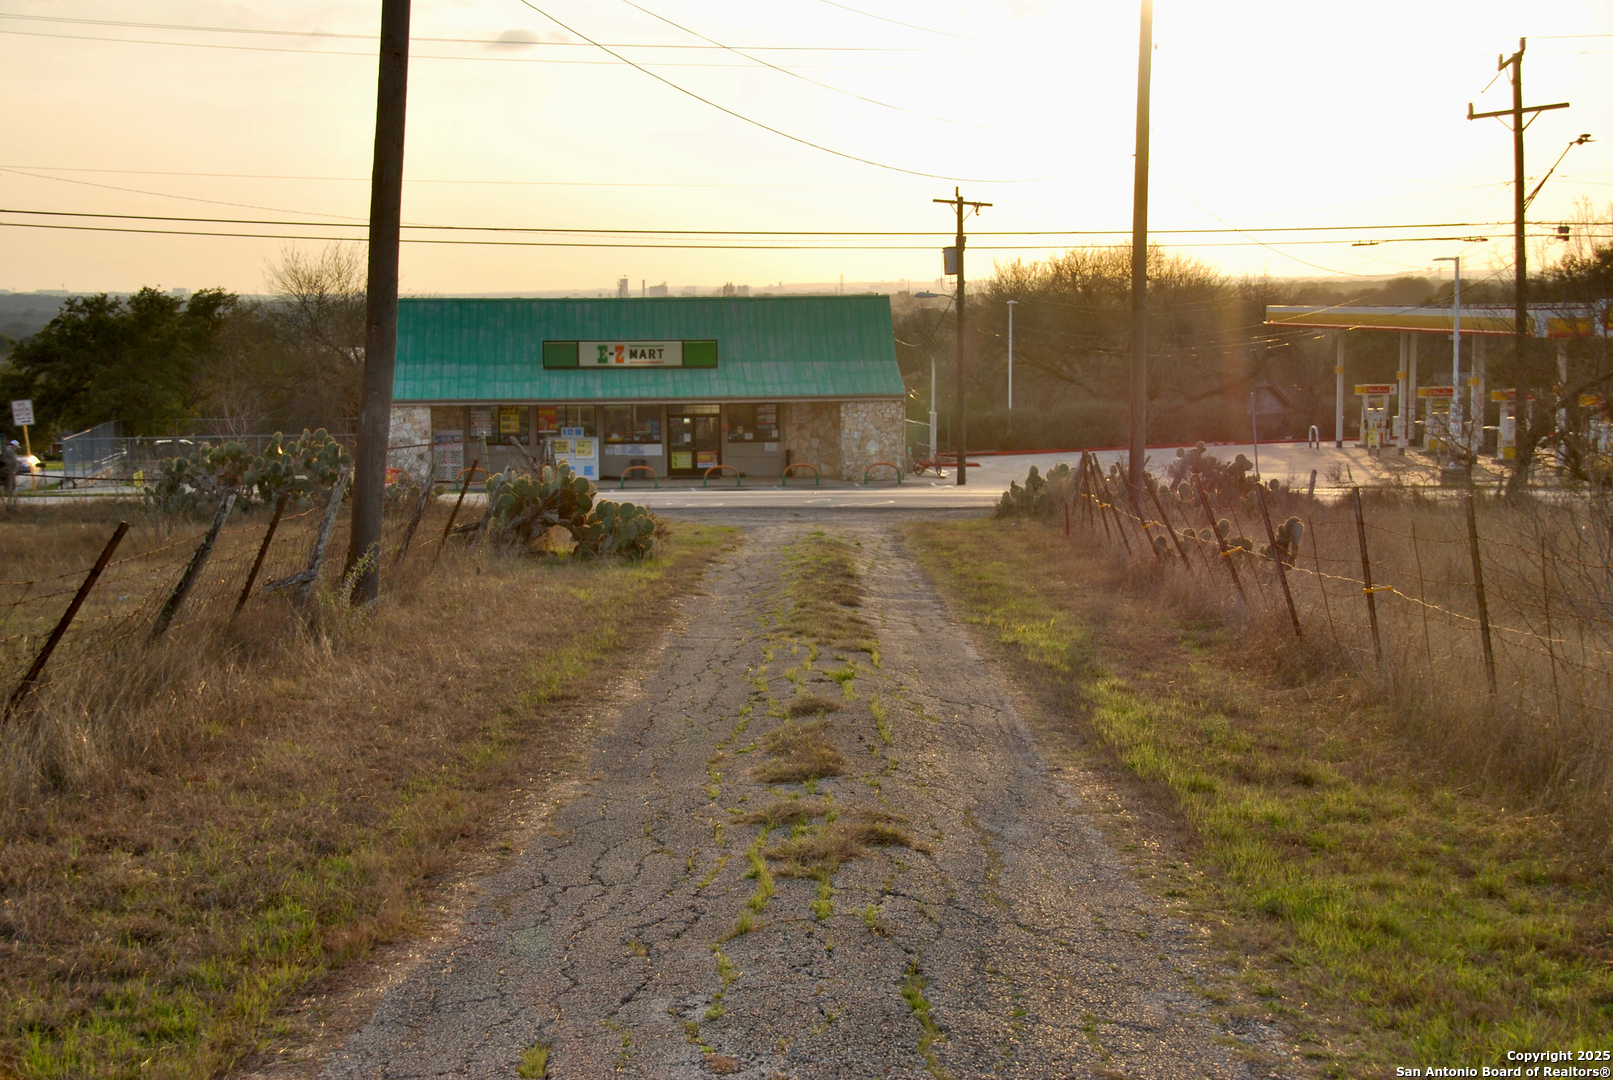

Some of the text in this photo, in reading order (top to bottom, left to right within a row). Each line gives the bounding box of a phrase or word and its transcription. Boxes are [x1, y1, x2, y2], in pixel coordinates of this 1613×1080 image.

[597, 345, 665, 364] E-Z MART
[562, 428, 582, 436] ICE
